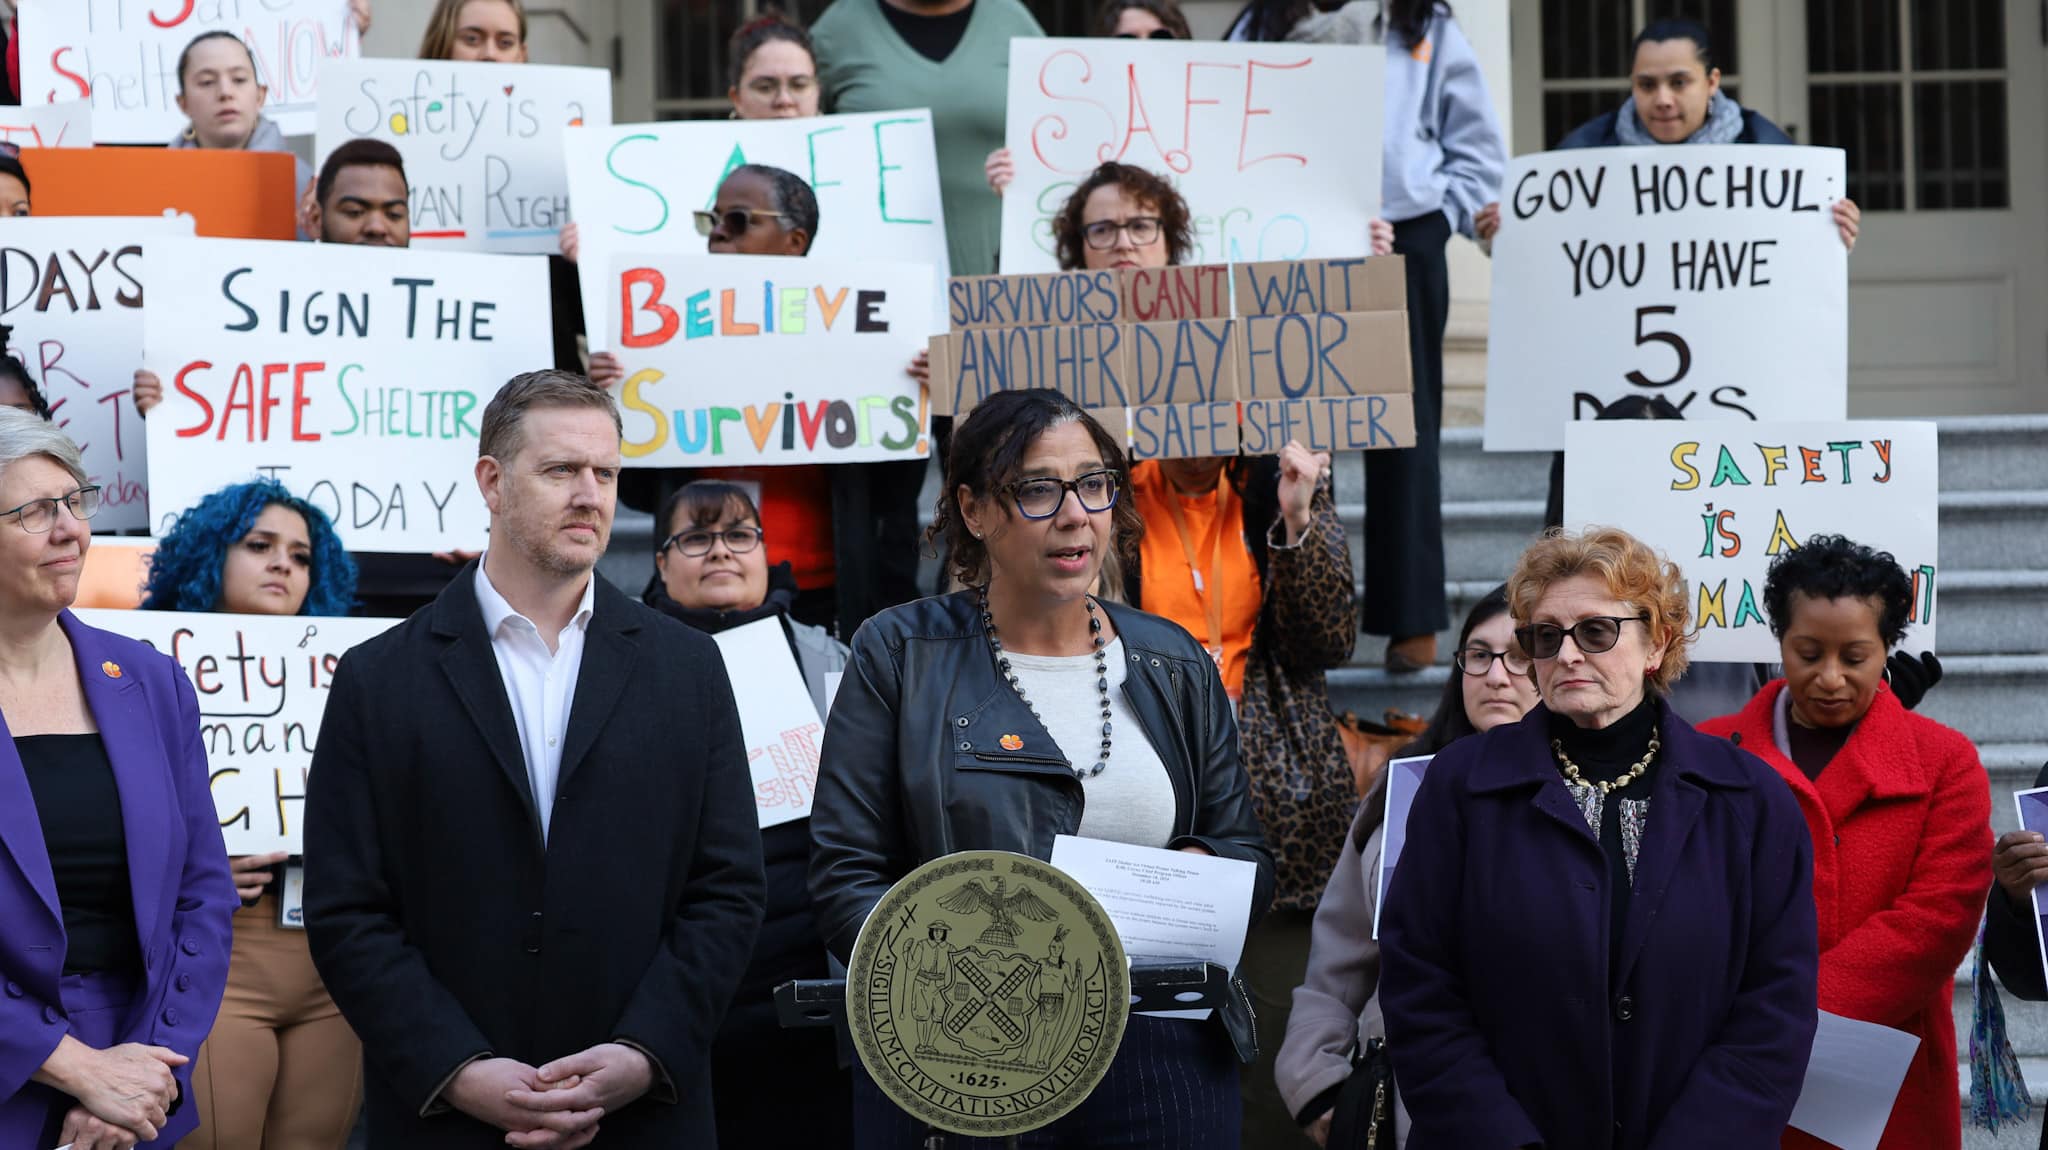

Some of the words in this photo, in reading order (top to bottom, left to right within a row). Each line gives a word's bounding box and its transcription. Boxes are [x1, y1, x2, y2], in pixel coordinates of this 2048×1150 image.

[48, 42, 180, 112] Shelt
[1032, 49, 1312, 174] SAFE
[344, 70, 488, 161] Safety
[502, 84, 540, 138] is
[484, 154, 571, 229] RIGH
[606, 118, 934, 235] SAFE
[1513, 165, 1606, 220] GOV
[0, 245, 144, 315] DAYS
[221, 267, 370, 337] SIGN
[392, 278, 496, 341] THE
[949, 267, 1119, 327] SURVIVORS
[1131, 264, 1229, 322] CAN'T
[1247, 258, 1366, 316] WAIT
[1561, 240, 1645, 297] YOU
[1672, 240, 1777, 291] HAVE
[951, 320, 1128, 417] ANOTHER
[1135, 318, 1232, 404] DAY
[1247, 311, 1356, 400] FOR
[1624, 305, 1692, 388] 5
[173, 360, 326, 443] SAFE
[330, 363, 480, 440] SHELTER
[1134, 400, 1239, 458] SAFE
[1245, 396, 1397, 456] SHELTER
[1670, 438, 1892, 491] SAFETY
[1765, 509, 1802, 556] A
[897, 1060, 1007, 1117] CIVITATIS
[1007, 1071, 1069, 1113] NOVI
[1068, 987, 1105, 1078] EBORACI
[957, 1070, 1002, 1089] 1625
